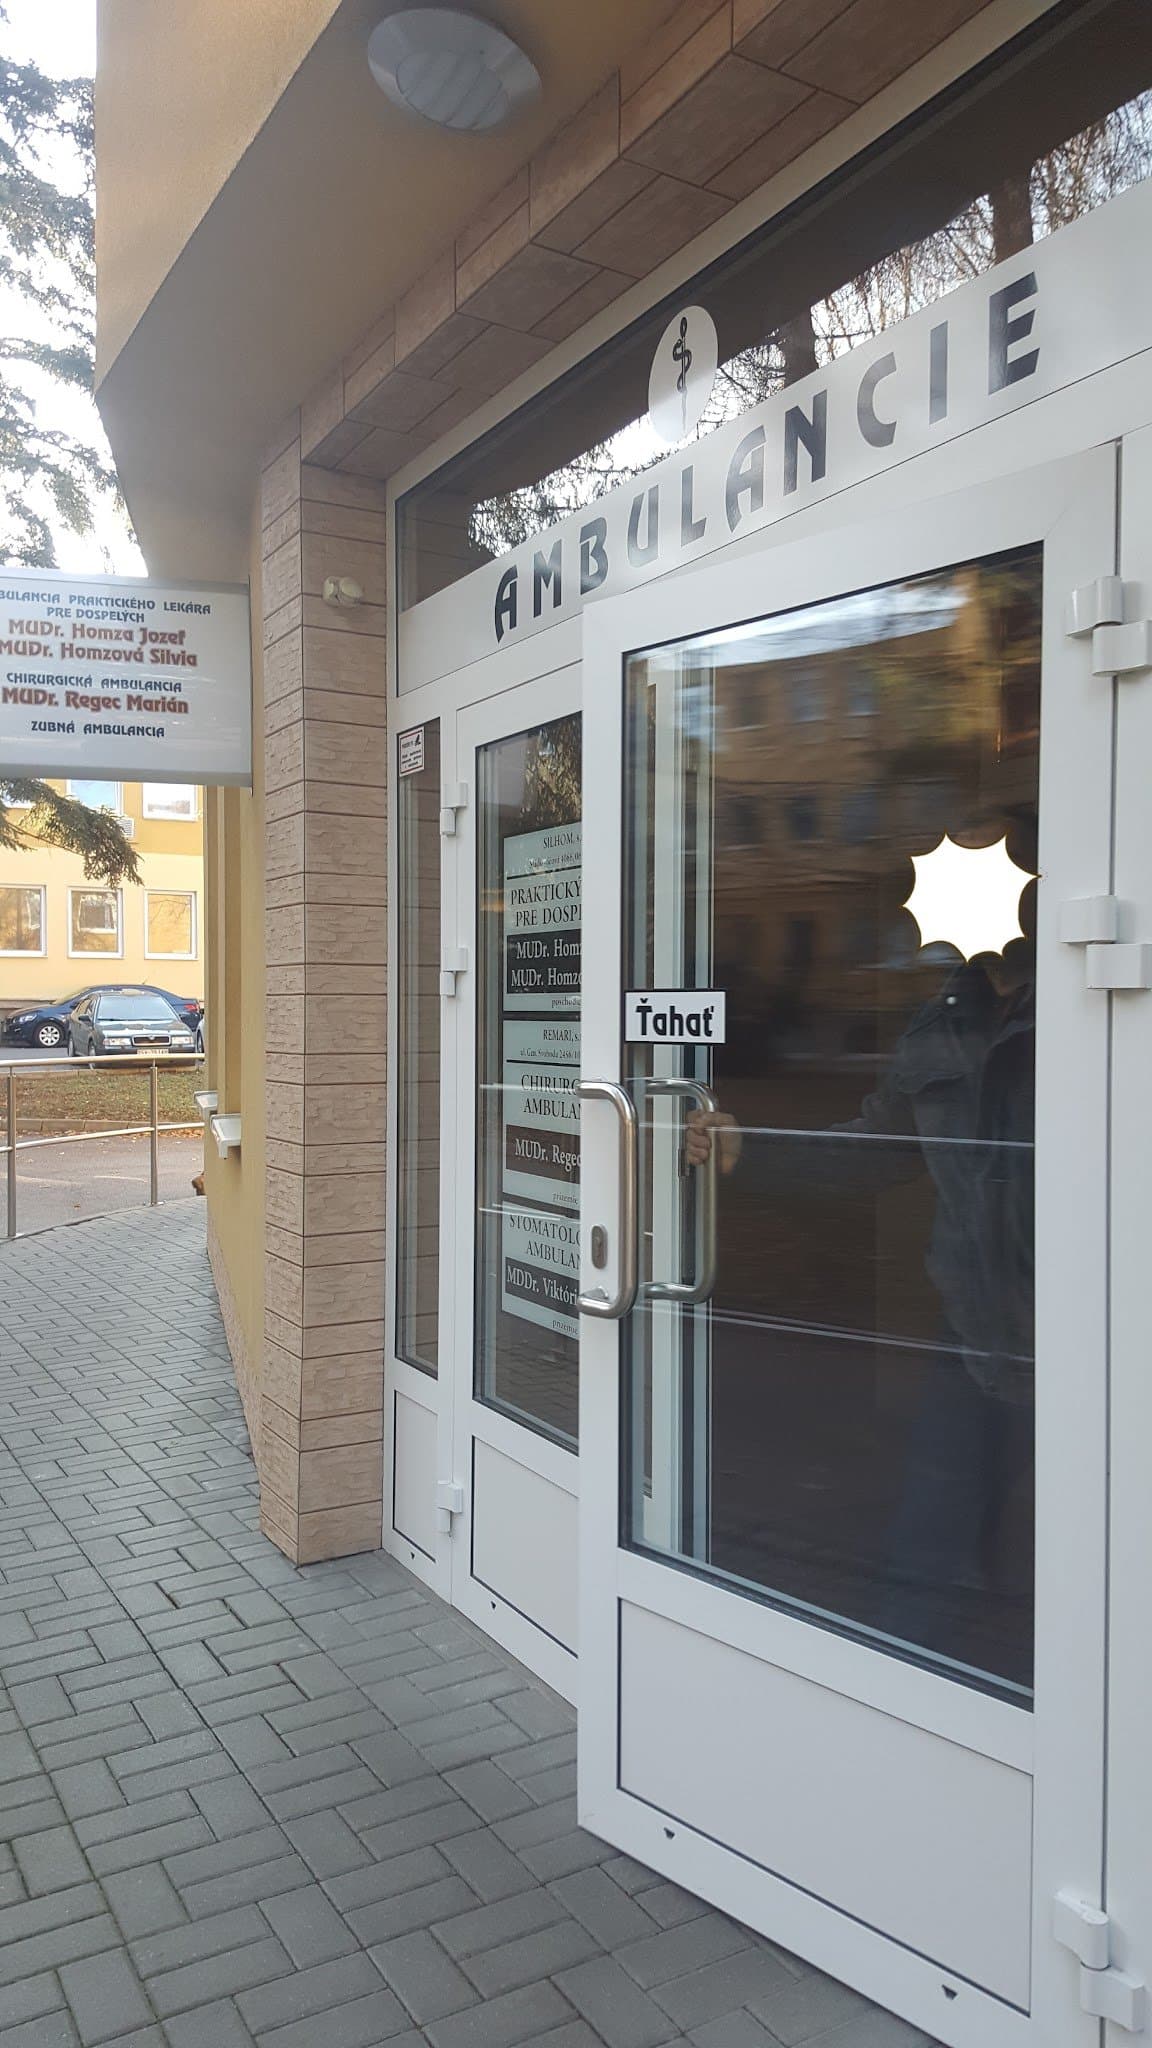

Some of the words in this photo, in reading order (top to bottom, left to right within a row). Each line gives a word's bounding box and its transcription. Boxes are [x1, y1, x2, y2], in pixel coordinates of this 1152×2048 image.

[494, 271, 1041, 644] AMBULANCIE
[47, 606, 71, 618] PRE
[76, 608, 145, 623] DOSPELÝCH
[69, 593, 155, 610] PRAKTICKÉHO
[163, 601, 211, 615] LEKÁRA
[8, 618, 64, 637] MUDr.
[72, 622, 134, 642] Homza
[139, 627, 186, 646] Jozef
[0, 639, 53, 657] MUDr.
[61, 642, 144, 663] Homzová
[150, 648, 198, 667] Silvia
[6, 672, 93, 688] CHIRURGICKÁ
[101, 677, 182, 693] AMBULANCIA
[2, 686, 59, 706] MUDr.
[65, 690, 121, 712] Regec
[127, 693, 189, 714] Marián
[31, 720, 75, 734] ZUBNÁ
[83, 723, 165, 738] AMBULANCIA
[515, 910, 538, 927] PRE
[516, 940, 550, 959] MUDr.
[511, 968, 544, 987] MUDr.
[635, 997, 715, 1038] Ťahať
[515, 1138, 548, 1161] MUDr.
[506, 1264, 540, 1293] MDDr.
